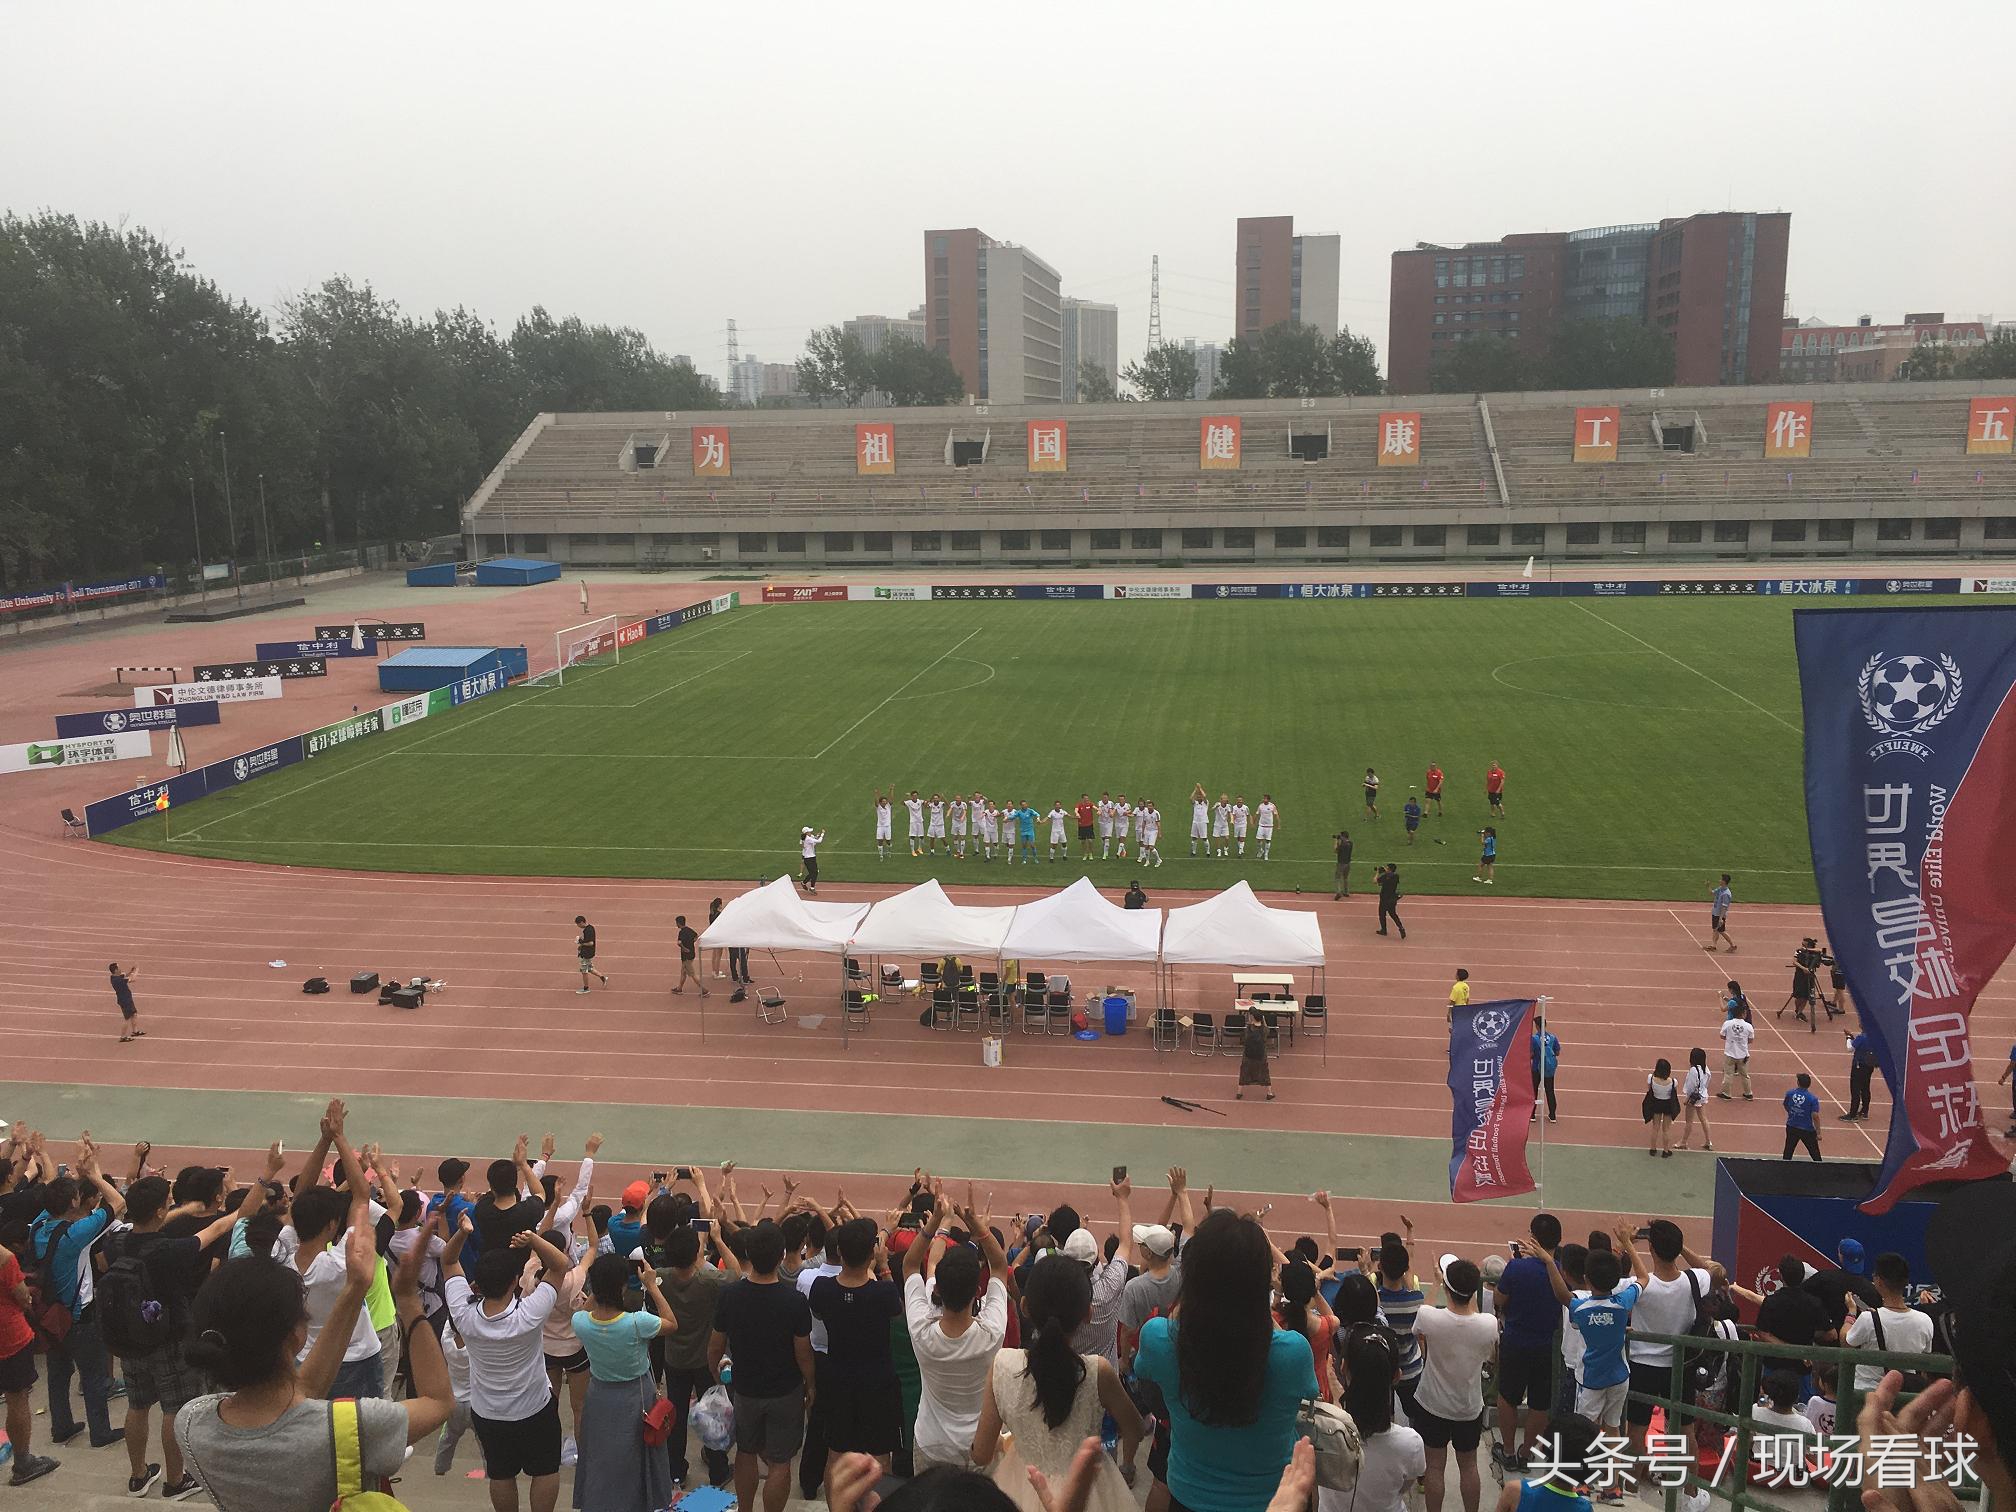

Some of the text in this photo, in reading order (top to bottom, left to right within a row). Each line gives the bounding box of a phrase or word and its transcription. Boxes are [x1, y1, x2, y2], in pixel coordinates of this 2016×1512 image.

[1650, 389, 1665, 398] E4
[1301, 398, 1315, 408] E3
[665, 411, 677, 420] E1
[976, 405, 989, 415] E2
[699, 407, 2010, 469] 为 祖 国 健 康 工 作 五
[14, 594, 54, 606] University
[85, 583, 128, 596] Tournament
[128, 580, 142, 590] 2017
[1301, 584, 1353, 597] 恒大冰泉
[1779, 581, 1837, 594] 恒大冰泉
[297, 642, 338, 651] 信中利
[178, 681, 263, 696] 中伦文德律师事务所
[461, 672, 497, 700] 恒大冰泉
[178, 694, 214, 703] ZHONGLUN
[129, 708, 177, 722] 奥世群星
[67, 747, 115, 759] 环宇体育
[128, 783, 169, 806] 信中利
